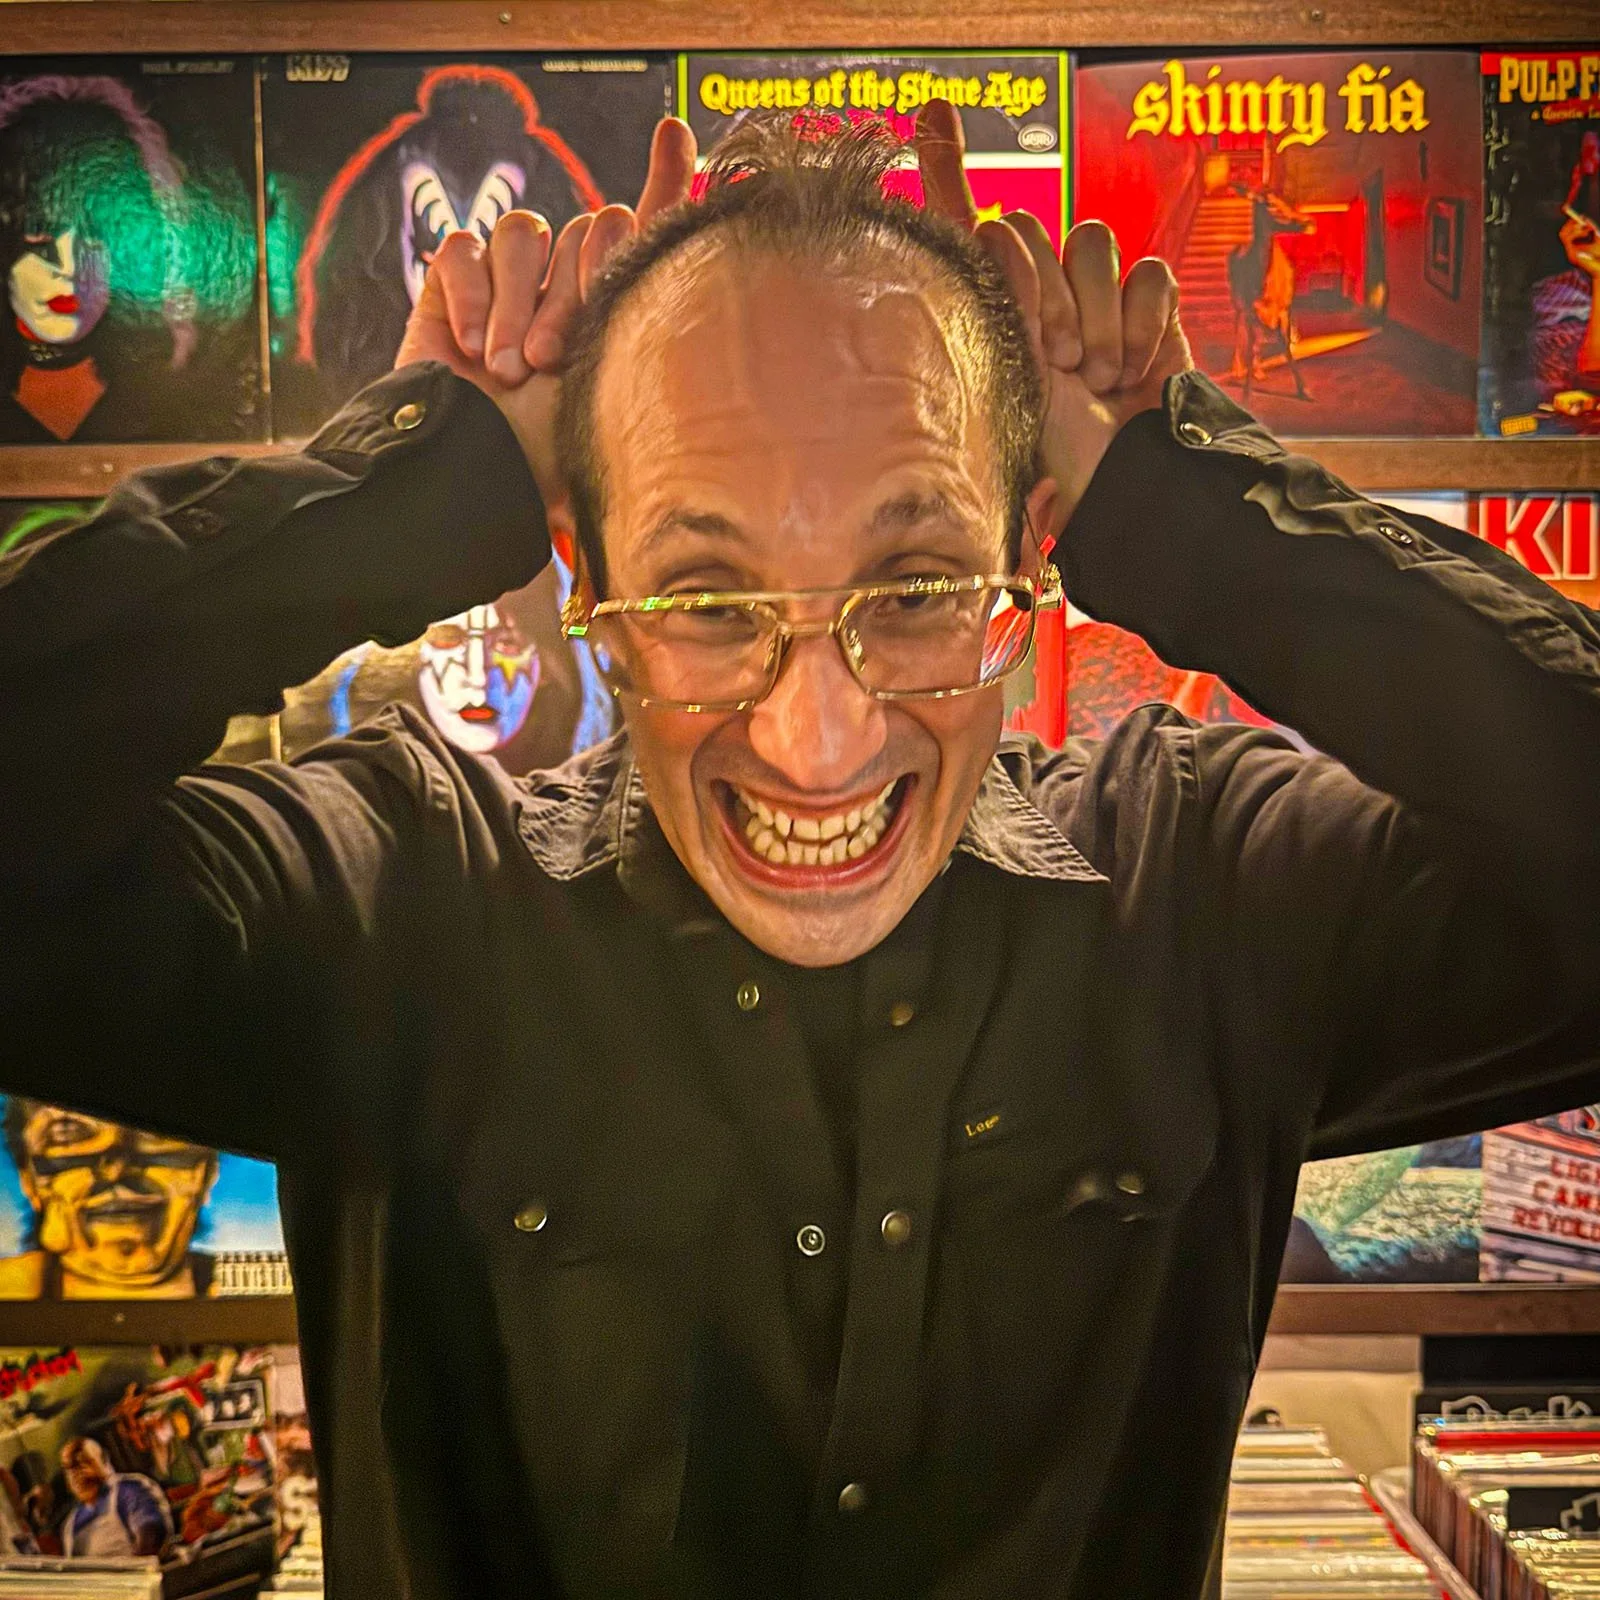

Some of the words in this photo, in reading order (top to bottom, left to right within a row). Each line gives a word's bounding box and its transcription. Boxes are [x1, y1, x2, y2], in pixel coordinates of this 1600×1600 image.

[700, 73, 811, 115] Queens
[813, 69, 847, 109] of
[849, 69, 896, 111] the
[896, 70, 983, 114] Stone
[981, 71, 1048, 117] Age
[1499, 55, 1576, 104] PULP
[1580, 55, 1600, 101] F
[1126, 59, 1329, 154] skinty
[1338, 62, 1431, 134] fia
[965, 1115, 999, 1137] Lee
[1533, 1180, 1600, 1214] CAM
